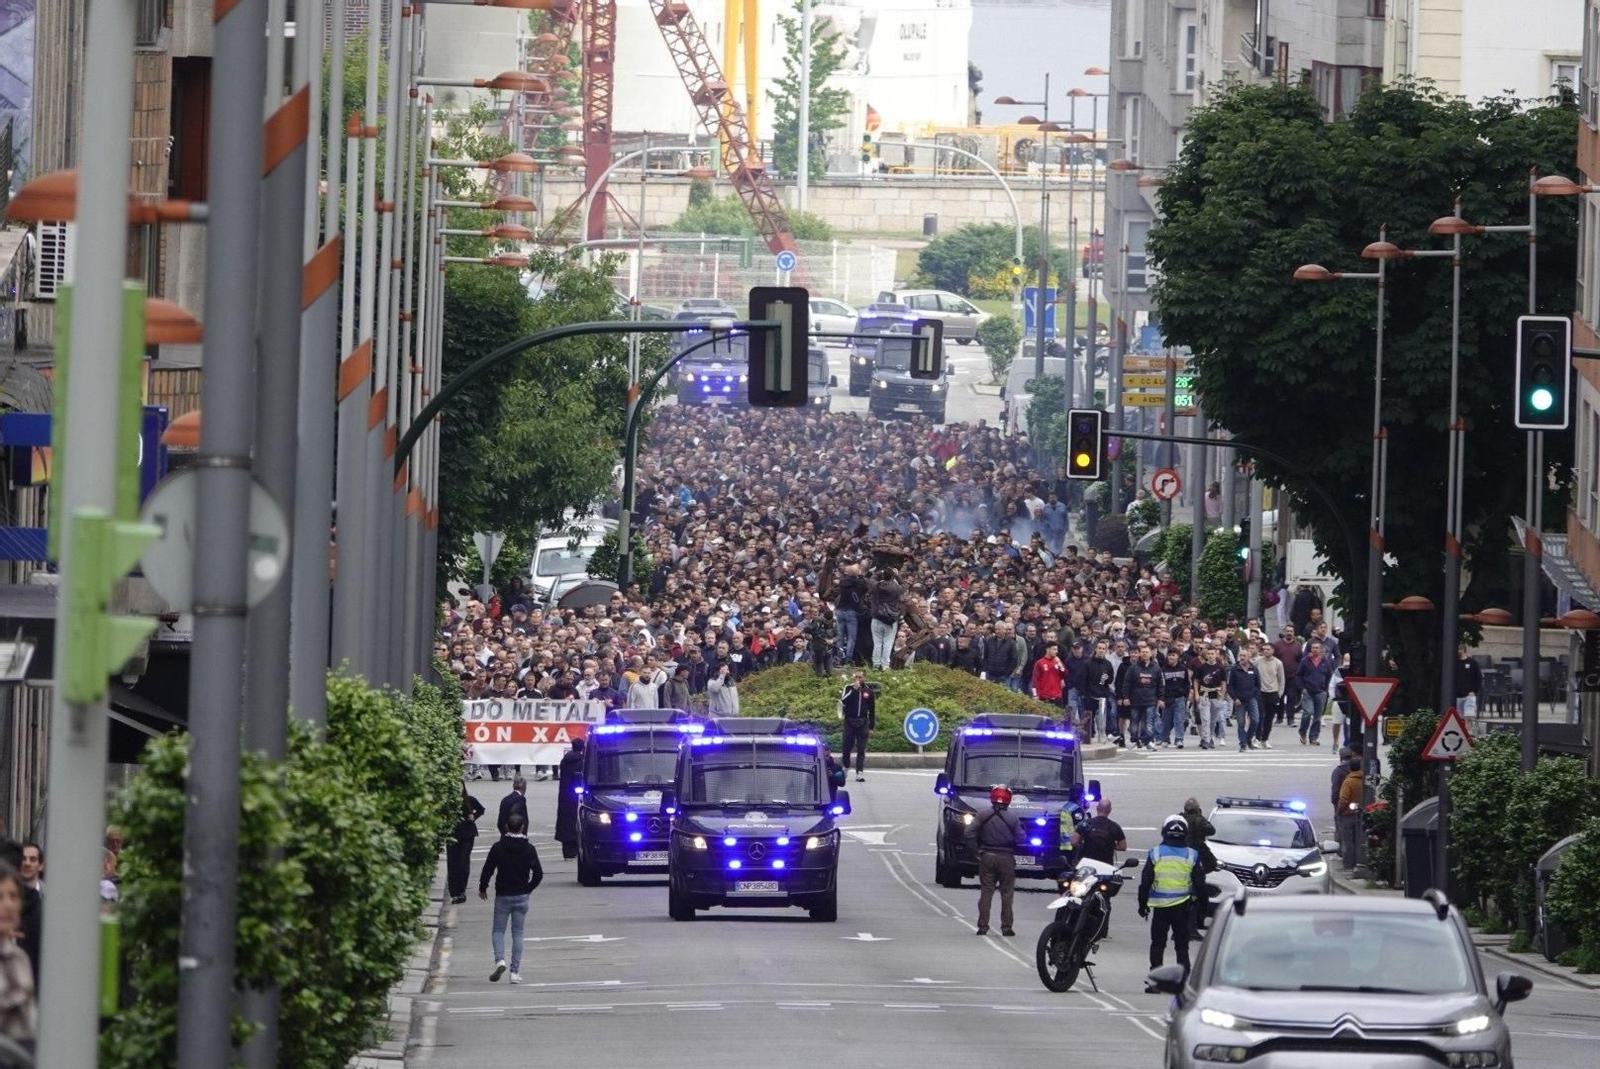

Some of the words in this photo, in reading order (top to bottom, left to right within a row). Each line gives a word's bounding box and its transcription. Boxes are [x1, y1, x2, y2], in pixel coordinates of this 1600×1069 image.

[470, 701, 503, 720] DO
[512, 701, 597, 721] METAL
[532, 727, 571, 742] XA
